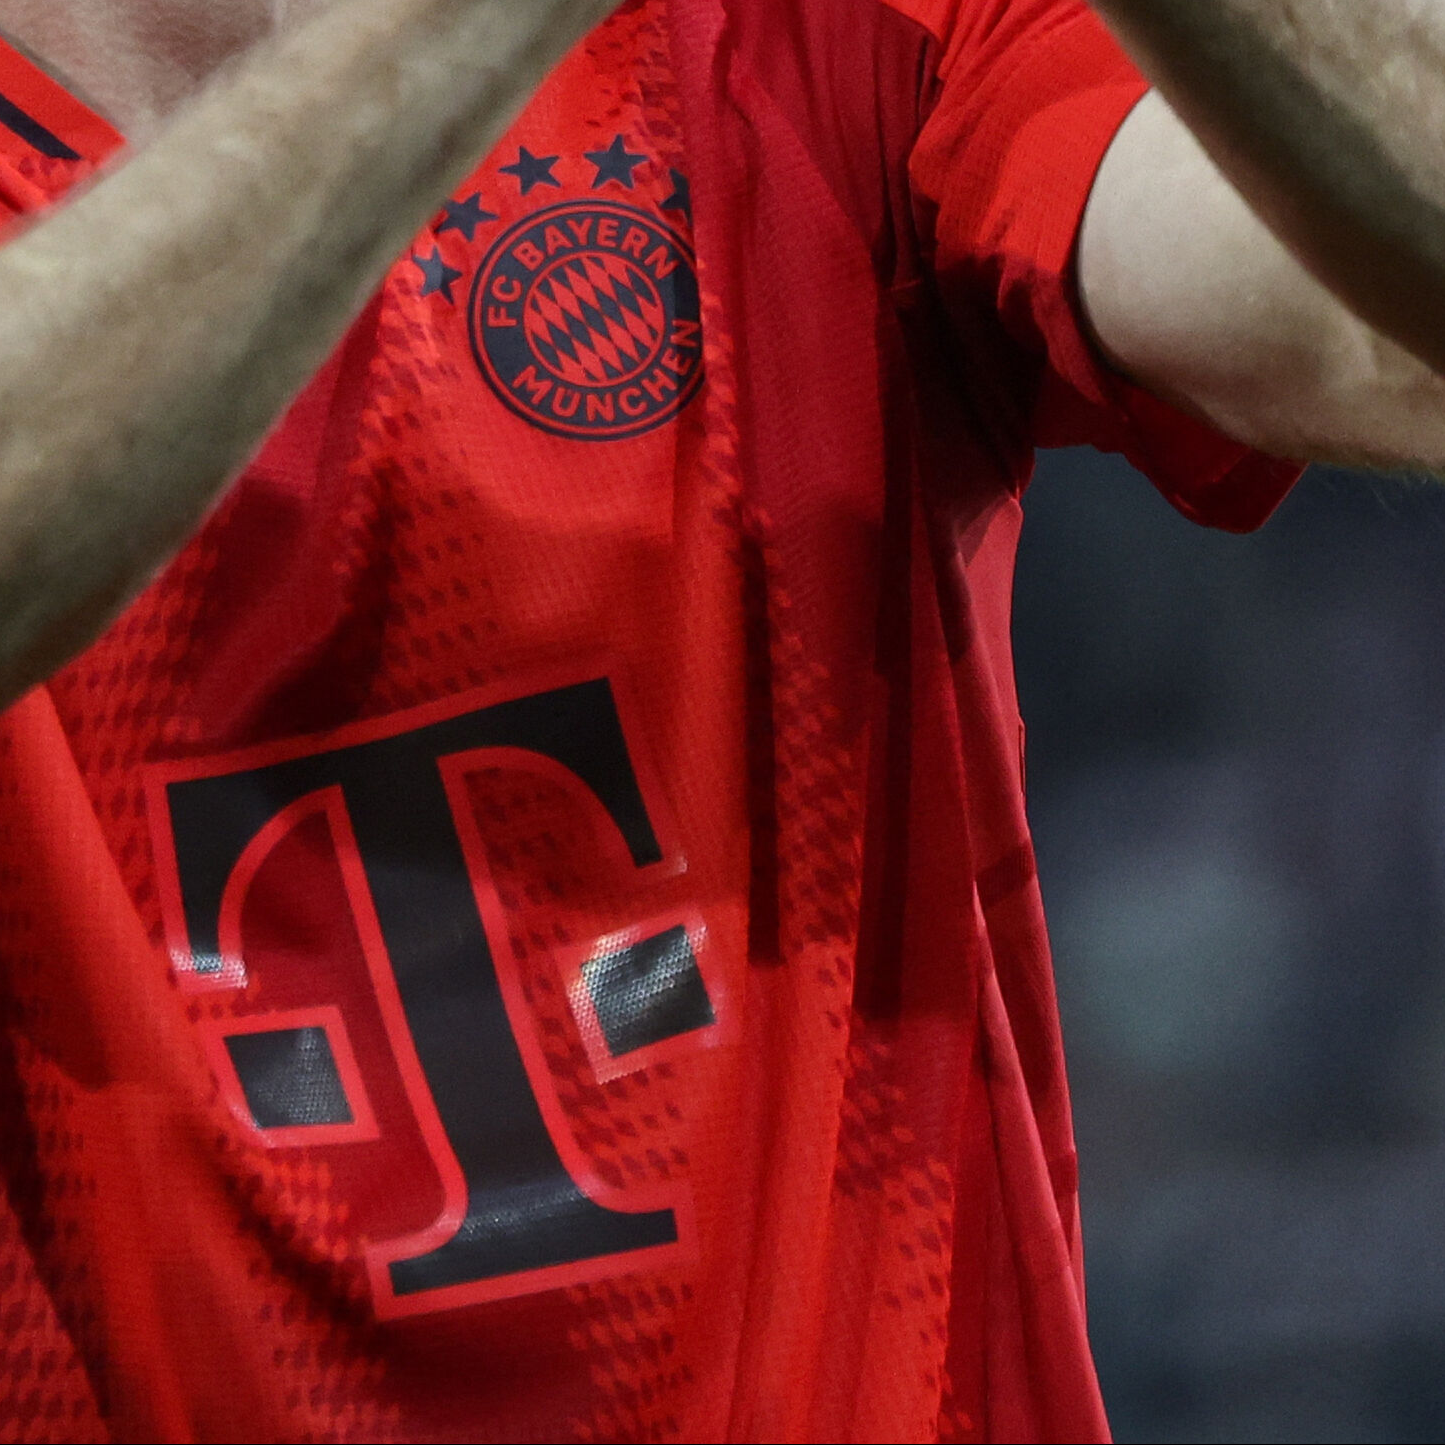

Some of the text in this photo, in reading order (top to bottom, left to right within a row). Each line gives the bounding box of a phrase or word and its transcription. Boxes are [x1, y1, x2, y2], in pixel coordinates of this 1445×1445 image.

[487, 217, 679, 328] FC BAYERN
[511, 319, 700, 422] MÜNCHEN
[162, 674, 682, 1304] T
